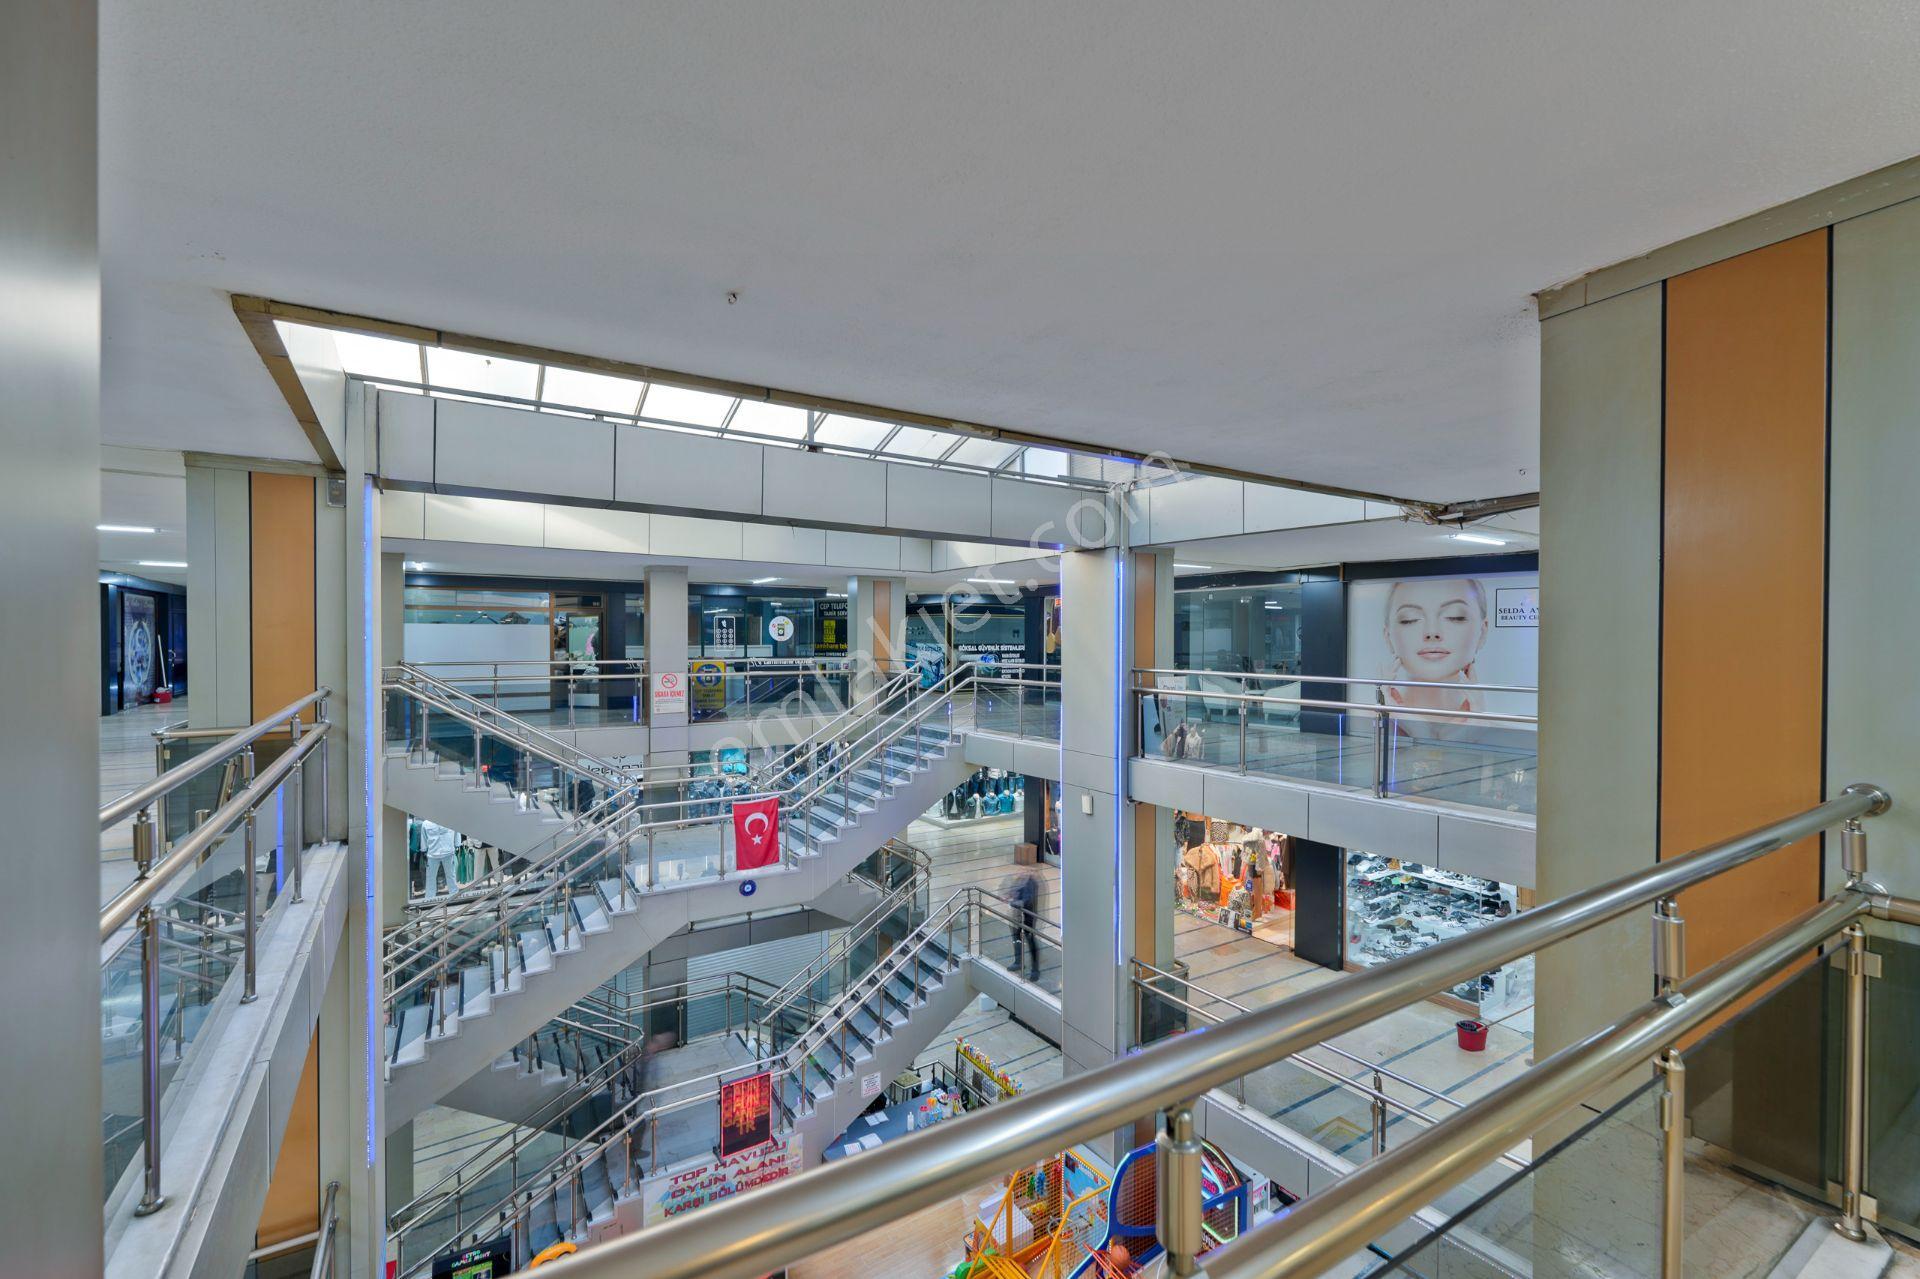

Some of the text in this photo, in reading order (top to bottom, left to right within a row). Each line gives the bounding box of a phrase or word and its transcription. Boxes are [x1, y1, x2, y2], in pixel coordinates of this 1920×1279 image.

[670, 1141, 787, 1185] TOP HAVUZU
[671, 1154, 786, 1199] OYUN ALANI
[664, 1195, 705, 1218] KARŞI
